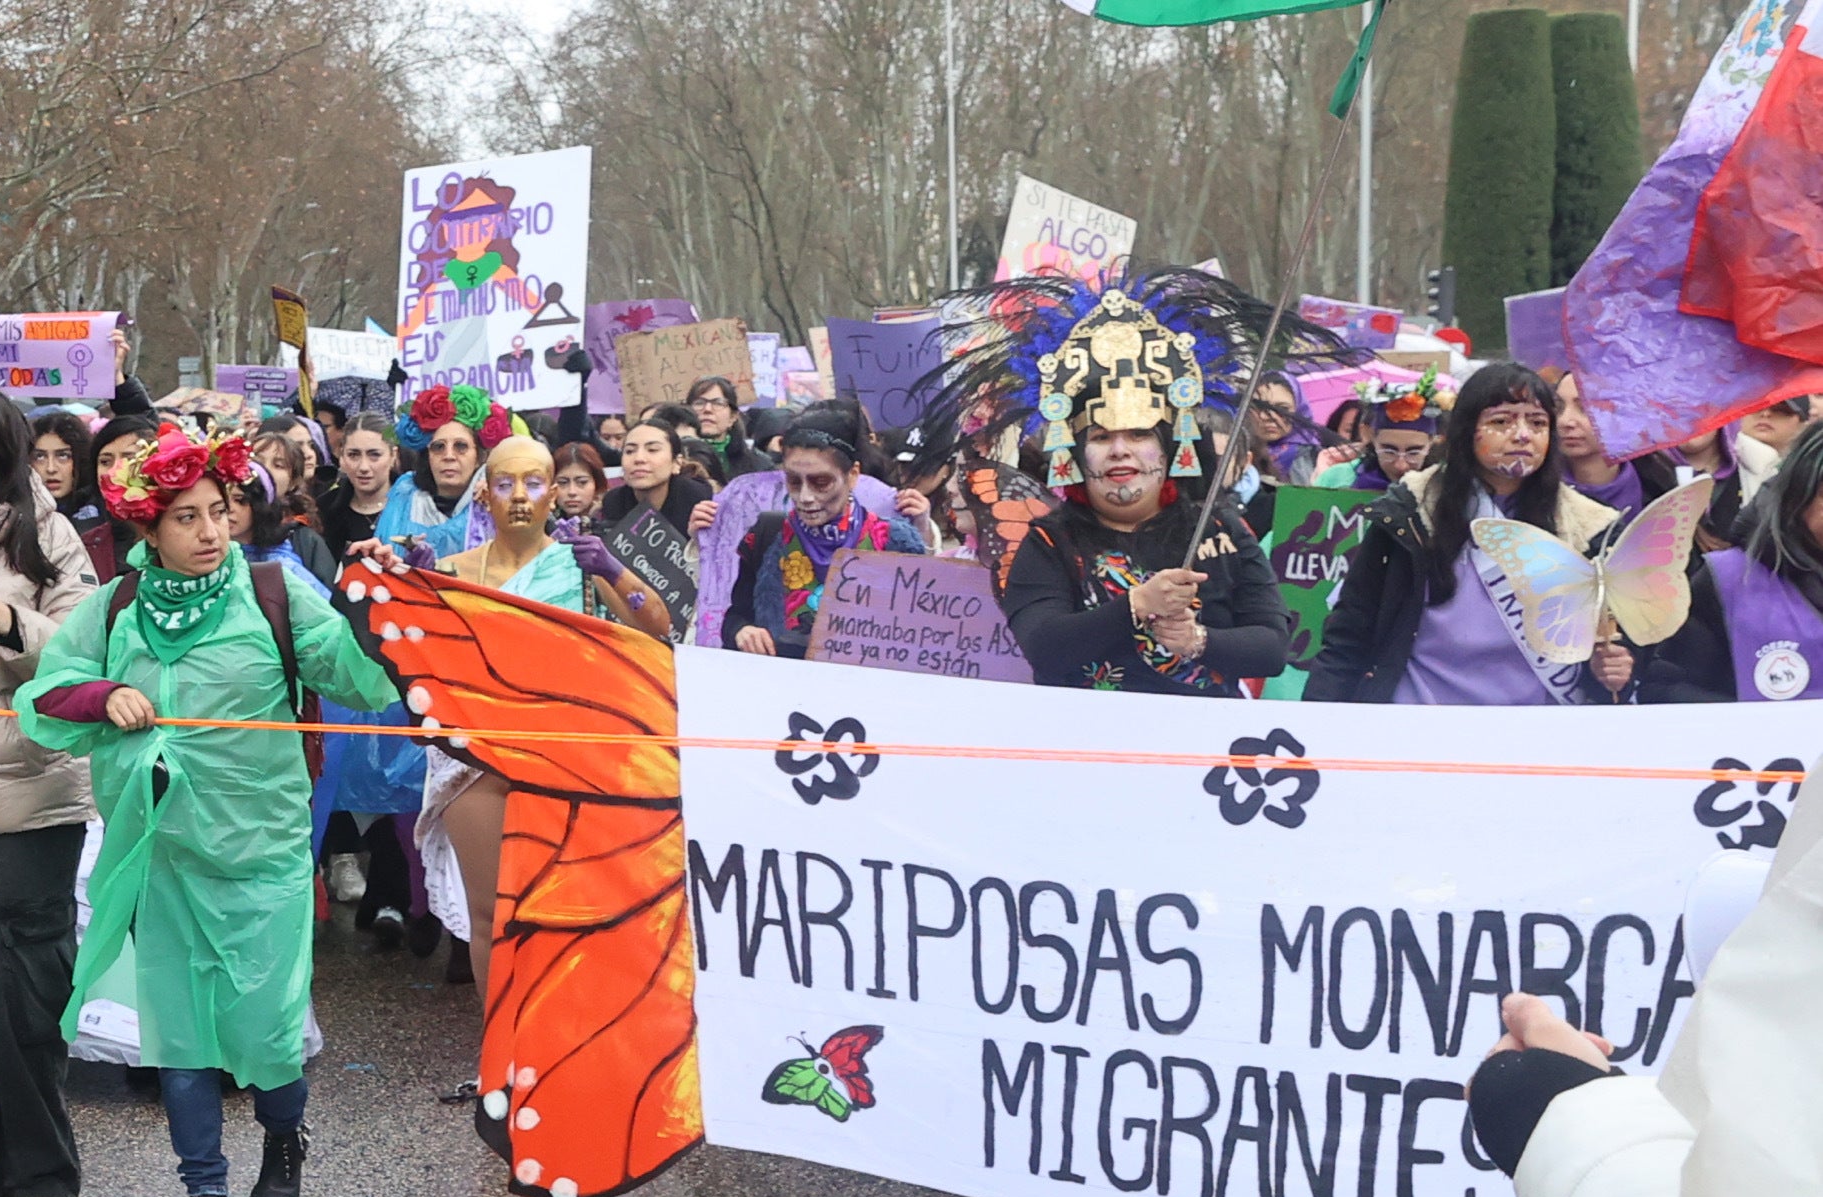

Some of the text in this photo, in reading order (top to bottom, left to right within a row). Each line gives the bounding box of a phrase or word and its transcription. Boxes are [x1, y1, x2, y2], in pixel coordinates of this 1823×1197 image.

[411, 171, 465, 213] LO
[1026, 183, 1129, 242] SI TE PASA
[408, 201, 554, 256] CONTRARIO
[1038, 216, 1108, 261] ALGO
[406, 257, 451, 290] DE
[404, 273, 544, 329] FEMINISMO
[25, 320, 90, 340] AMIGAS
[402, 330, 446, 368] ES
[641, 517, 667, 548] YO
[612, 532, 635, 557] NO
[665, 590, 681, 605] A
[835, 556, 983, 620] En México
[827, 612, 917, 647] marchaba
[918, 625, 954, 648] por
[824, 637, 981, 679] que ya no están
[687, 838, 1202, 1036] MARIPOSAS
